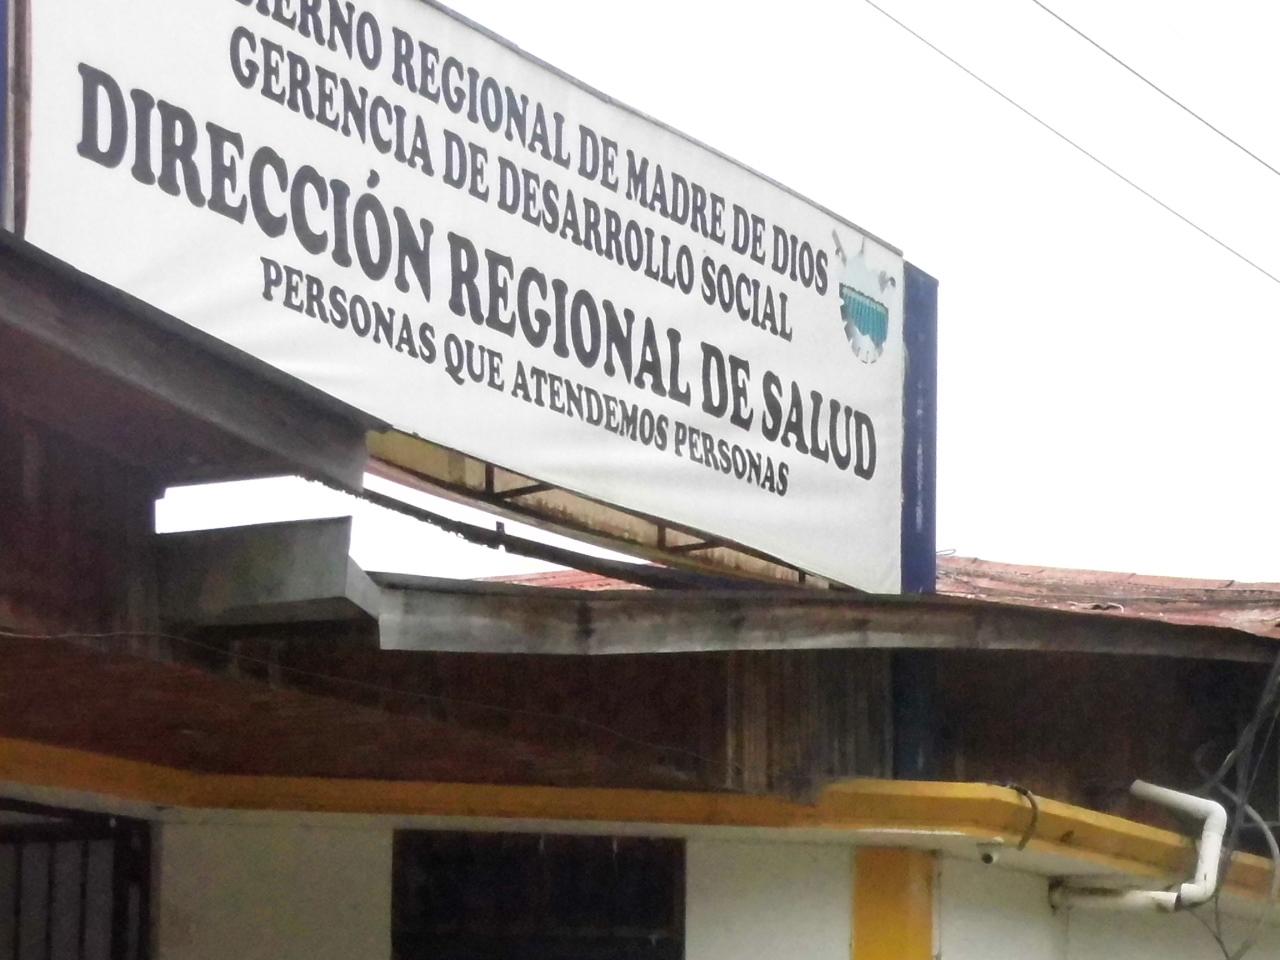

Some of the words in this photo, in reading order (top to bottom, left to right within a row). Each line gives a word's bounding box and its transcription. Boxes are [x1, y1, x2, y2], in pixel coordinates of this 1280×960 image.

[76, 61, 435, 303] DIRECCIÓN
[446, 231, 691, 407] REGIONAL
[700, 341, 754, 432] DE
[761, 370, 877, 481] SALUD
[229, 25, 435, 178] GERENCIA
[442, 128, 490, 203] DE
[497, 155, 695, 295] DESARROLLO
[700, 255, 793, 343] SOCIAL
[391, 26, 571, 170] REGIONAL
[577, 124, 619, 193] DE
[625, 149, 726, 246] MADRE
[731, 203, 766, 266] DE
[771, 224, 829, 297] DIOS
[259, 256, 437, 365] PERSONAS
[443, 333, 505, 393] QUE
[510, 360, 669, 451] ATENDEMOS
[674, 420, 790, 497] PERSONAS
